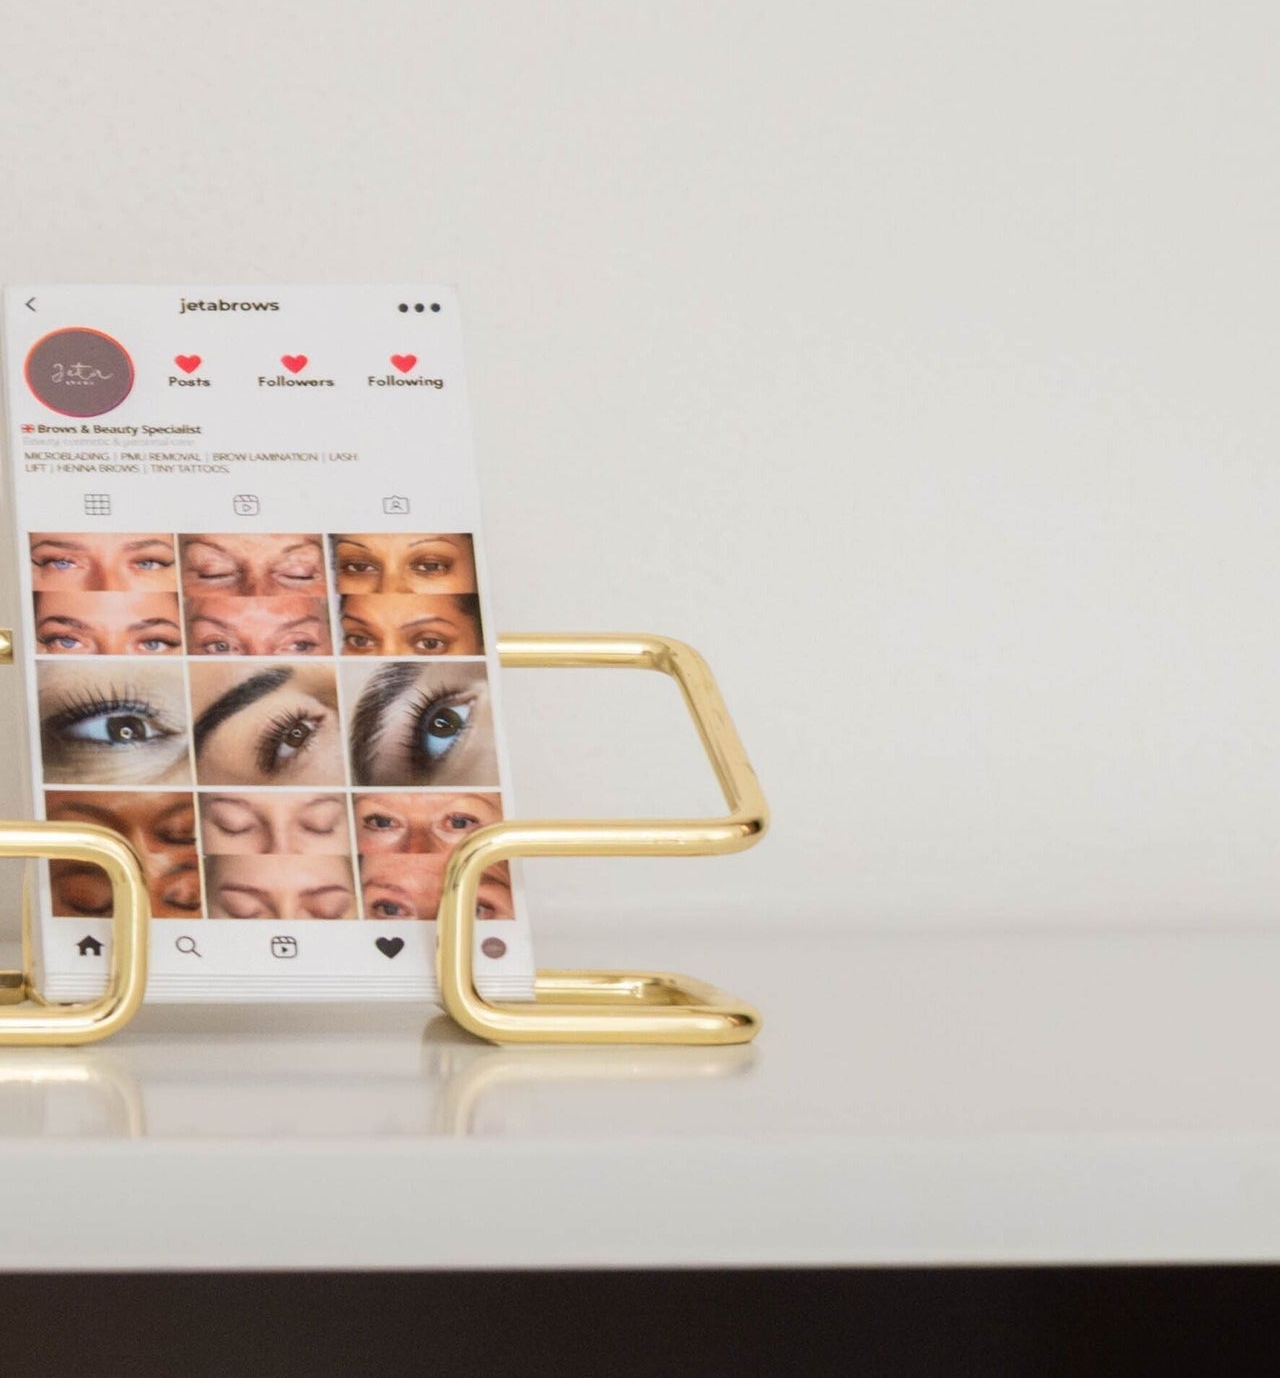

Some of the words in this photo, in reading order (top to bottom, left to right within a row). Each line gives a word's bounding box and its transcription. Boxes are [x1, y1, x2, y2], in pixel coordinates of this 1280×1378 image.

[179, 297, 280, 315] jetabrows
[168, 376, 212, 388] Posts
[257, 375, 335, 388] Followers
[367, 375, 444, 390] Following
[37, 424, 78, 434] Brows
[81, 424, 90, 434] &
[93, 424, 138, 437] Beauty
[141, 424, 202, 437] Specialist
[24, 451, 110, 461] MICROBLADING
[148, 452, 201, 461] REMOVAL
[212, 452, 248, 462] BROW
[248, 452, 319, 462] LAMINATION
[329, 453, 358, 462] LASH
[25, 463, 47, 473] LIFT
[56, 463, 97, 473] HENNA
[98, 463, 140, 473] BROWS
[150, 464, 175, 473] TINY
